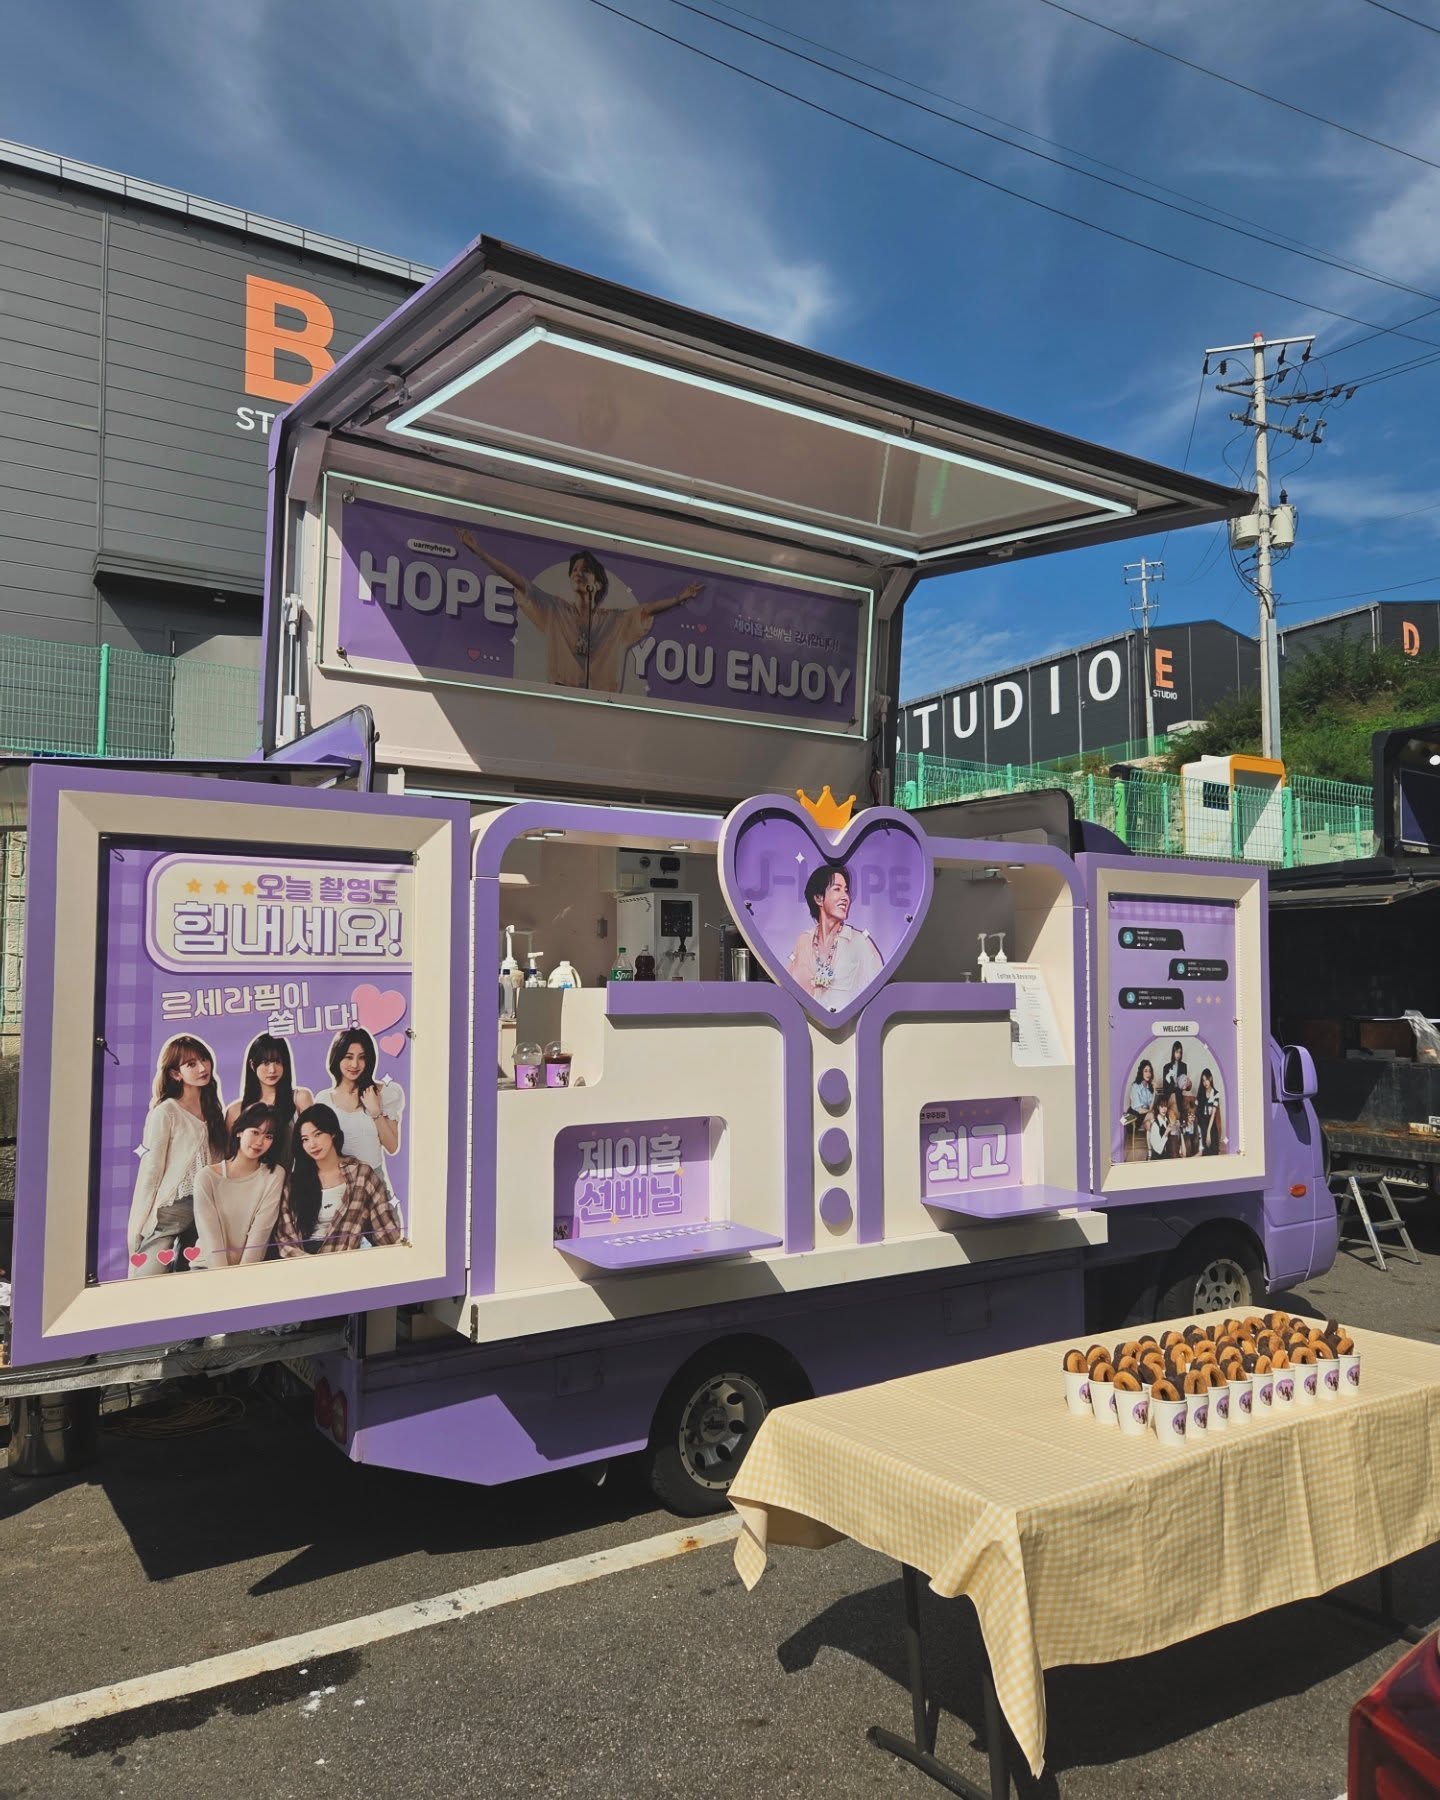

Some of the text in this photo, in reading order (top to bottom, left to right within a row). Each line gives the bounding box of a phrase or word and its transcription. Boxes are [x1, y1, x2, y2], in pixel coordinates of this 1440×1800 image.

[245, 274, 336, 405] B
[236, 406, 275, 433] ST
[413, 542, 451, 553] uarmyhope
[358, 550, 515, 625] HOPE
[1402, 621, 1420, 656] D
[631, 636, 850, 703] YOU ENJOY
[1155, 648, 1174, 689] E
[897, 650, 1121, 752] TUDIO
[1153, 690, 1178, 700] STUDIO
[256, 874, 397, 905] 오늘 촬영도
[745, 850, 912, 908] J-PE
[173, 901, 402, 956] 힘내세요!
[161, 981, 310, 1021] 르세라핌이
[267, 1002, 360, 1037] 쏩니다!
[1162, 1025, 1190, 1033] WELCOME
[578, 1133, 682, 1180] 제이홉
[928, 1124, 1009, 1182] 최고
[578, 1173, 682, 1224] 선배님
